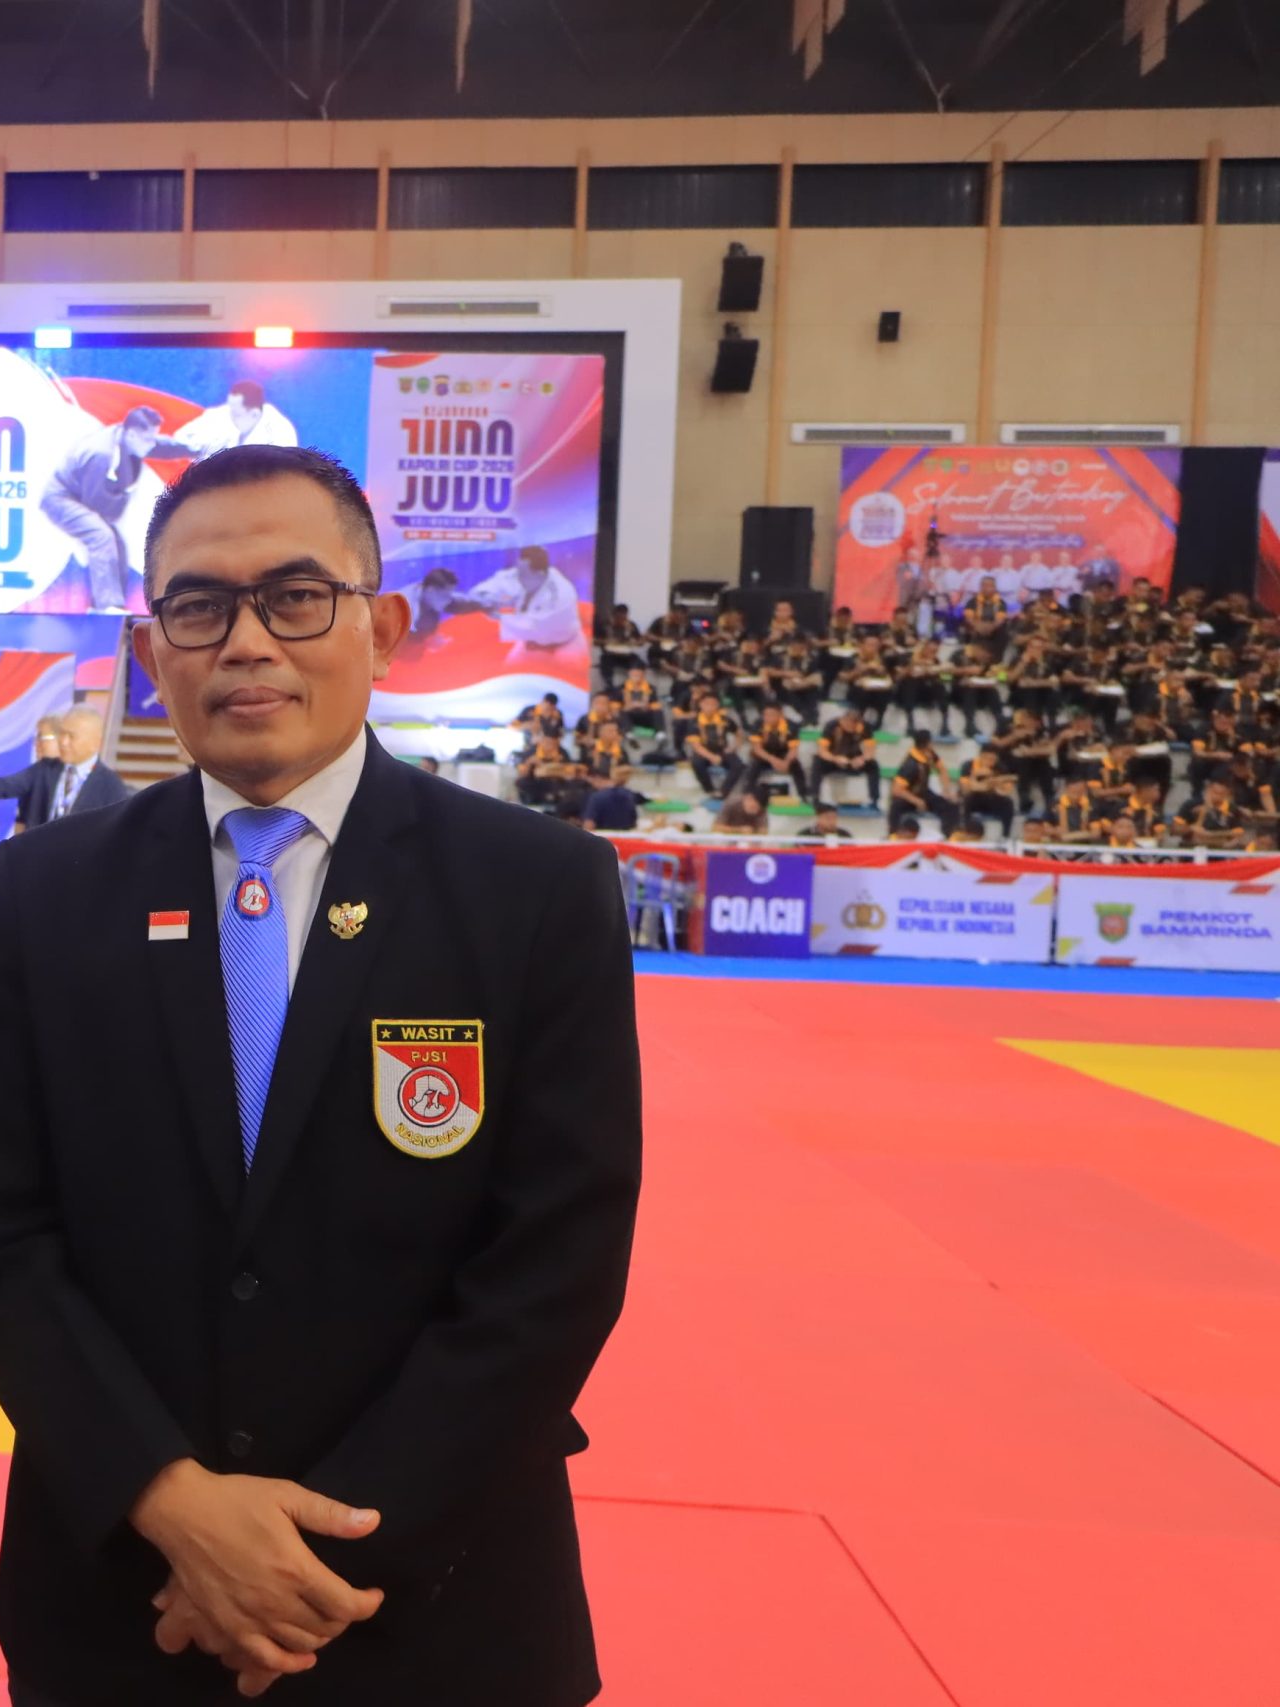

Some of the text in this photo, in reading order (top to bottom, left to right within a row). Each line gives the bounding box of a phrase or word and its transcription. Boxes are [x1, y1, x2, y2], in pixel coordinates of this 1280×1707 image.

[453, 460, 479, 472] CUP
[710, 895, 805, 935] COACH
[970, 901, 1015, 916] NEGARA
[1159, 910, 1253, 924] PEMKOT
[1140, 923, 1271, 938] SAMARINDA
[401, 1026, 455, 1041] WASIT
[411, 1050, 447, 1063] PJSI
[395, 1123, 464, 1148] NASIONAL
